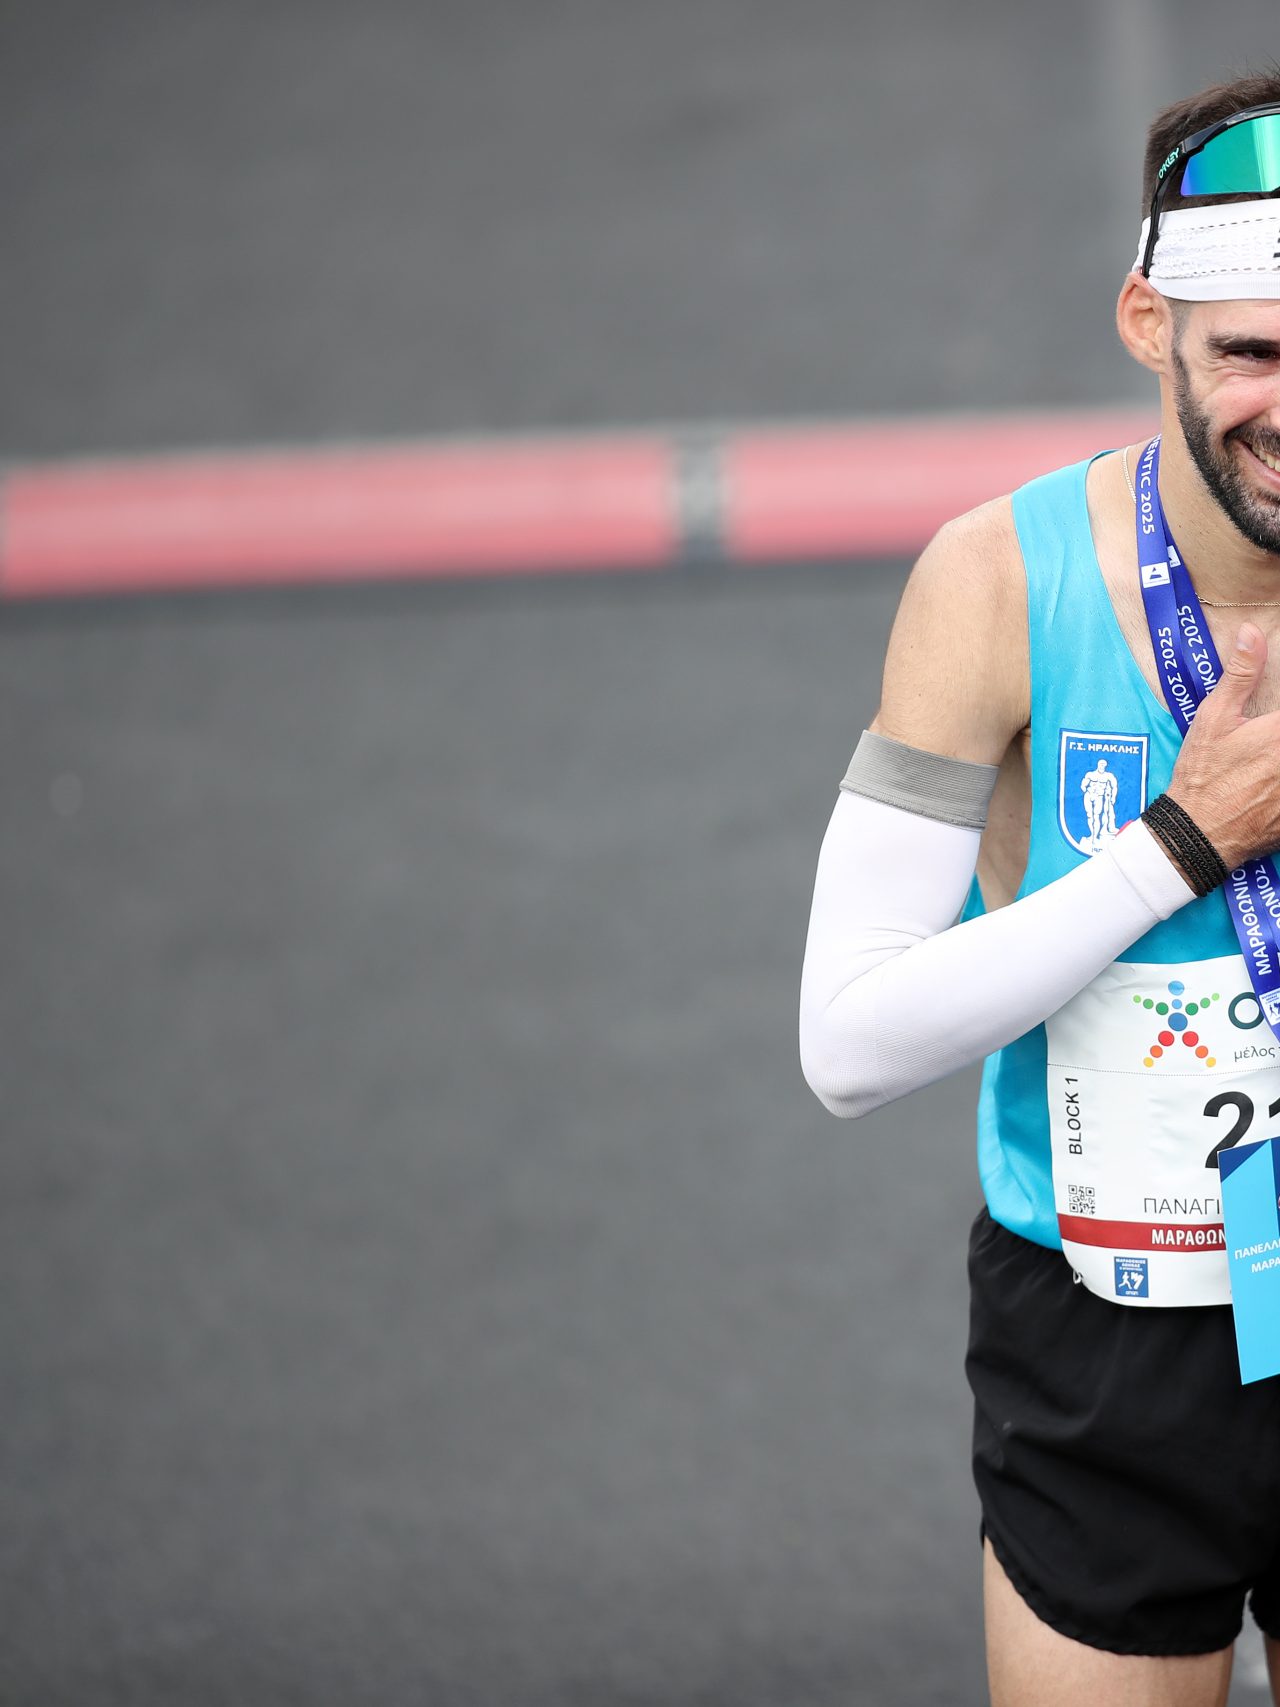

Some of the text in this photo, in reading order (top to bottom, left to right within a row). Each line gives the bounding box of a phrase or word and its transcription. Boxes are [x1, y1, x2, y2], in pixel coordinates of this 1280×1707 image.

[1141, 492, 1155, 535] 2025
[1158, 626, 1178, 670] 2025
[1177, 605, 1203, 648] 2025
[1069, 741, 1140, 755] Γ.Σ. ΗΡΑΚΛΗΣ
[1065, 1076, 1083, 1155] BLOCK 1
[1143, 1197, 1221, 1215] ΠΑΝΑΓΙ
